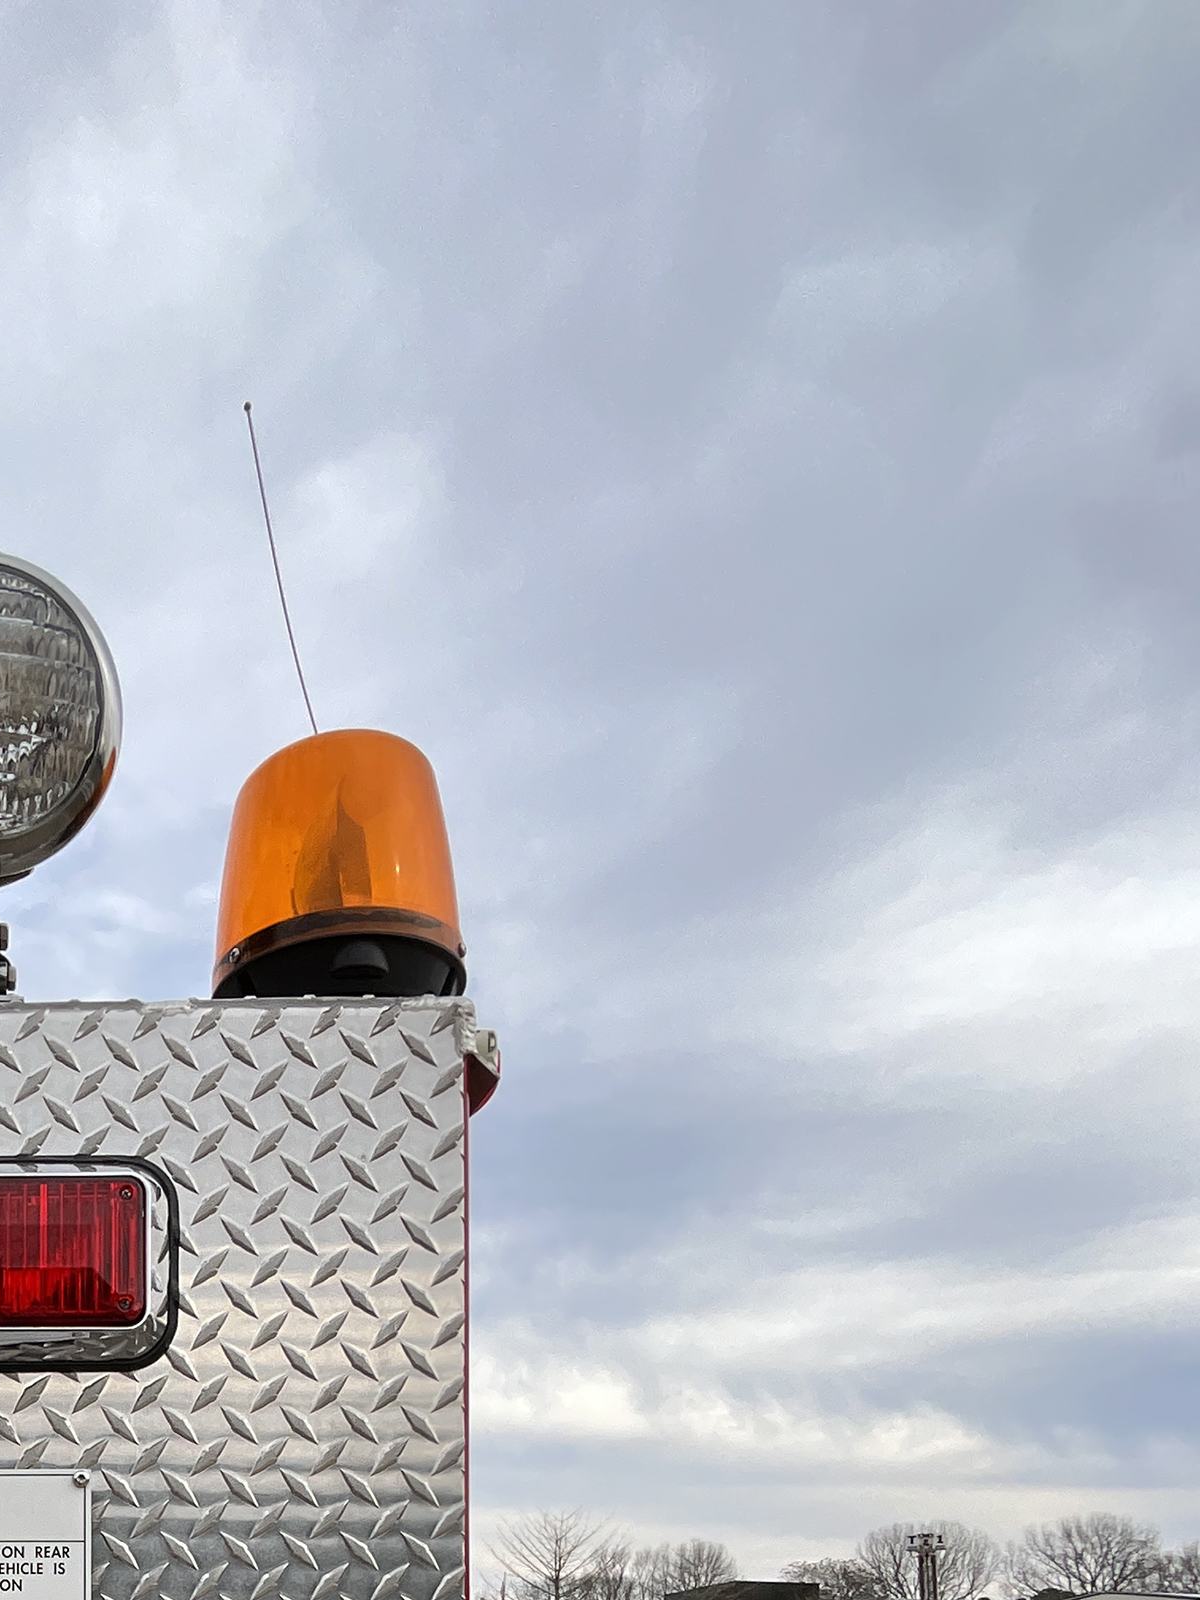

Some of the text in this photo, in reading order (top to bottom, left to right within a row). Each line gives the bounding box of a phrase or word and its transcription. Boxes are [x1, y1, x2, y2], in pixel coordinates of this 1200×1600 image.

[1, 1546, 25, 1558] ON
[35, 1546, 70, 1558] REAR
[54, 1563, 66, 1575] IS
